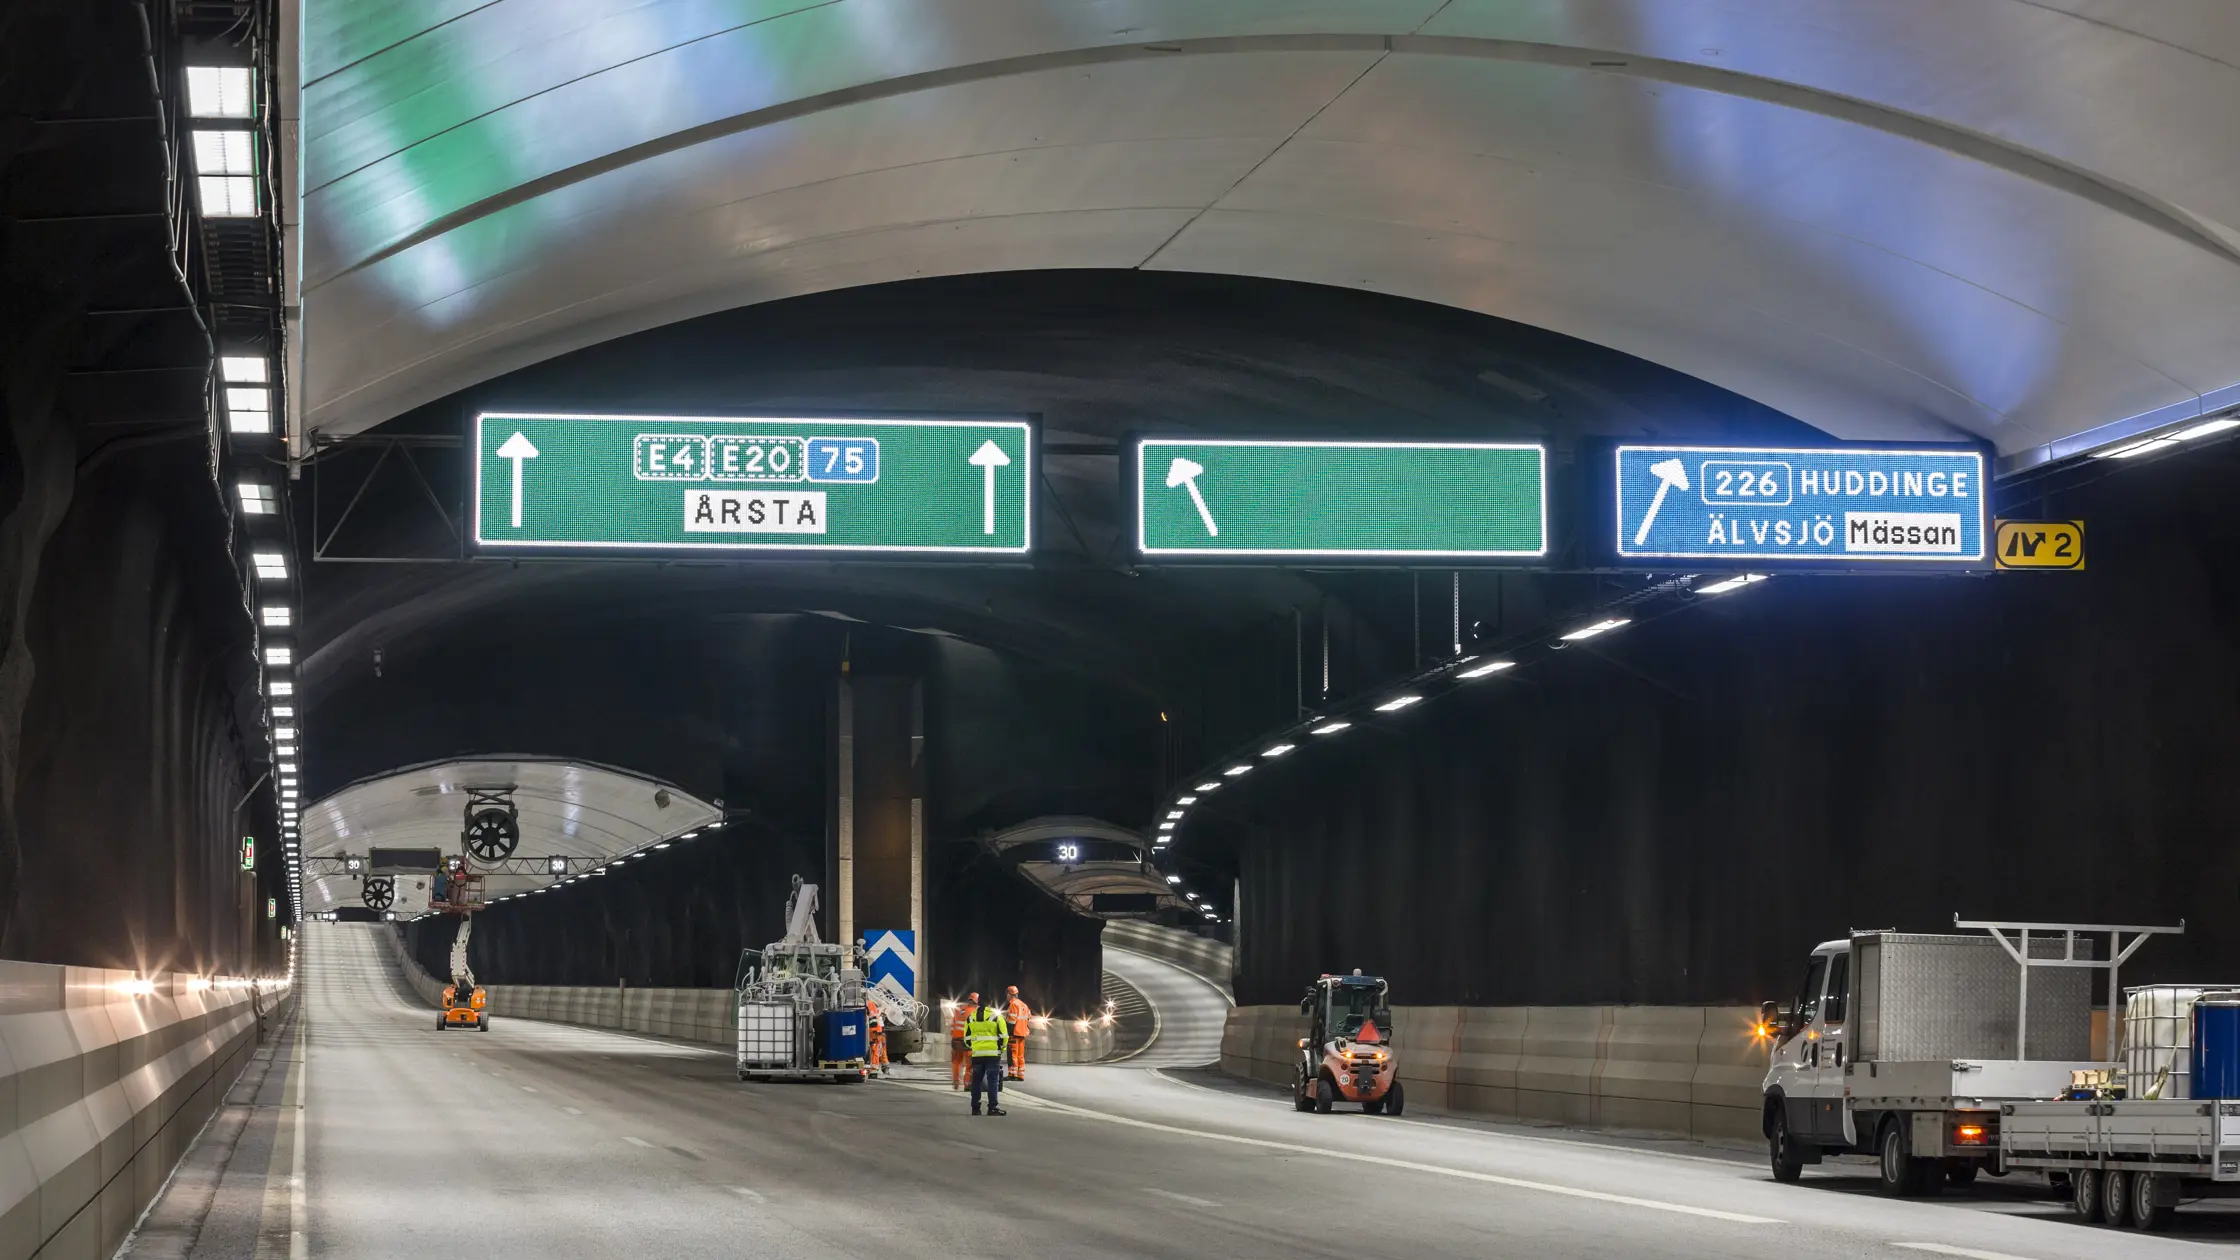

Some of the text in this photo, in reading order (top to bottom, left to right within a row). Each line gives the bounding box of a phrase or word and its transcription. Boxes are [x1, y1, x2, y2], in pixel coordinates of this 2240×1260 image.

[649, 443, 865, 475] E4 E20 75
[1714, 469, 1968, 498] 226 HUDDINGE
[695, 494, 816, 526] ÅRSTA
[1707, 512, 1956, 546] ÄLVSJÖ Mässan
[2054, 532, 2072, 557] 2
[348, 859, 360, 869] 30
[552, 860, 565, 870] 30
[1058, 846, 1077, 859] 30
